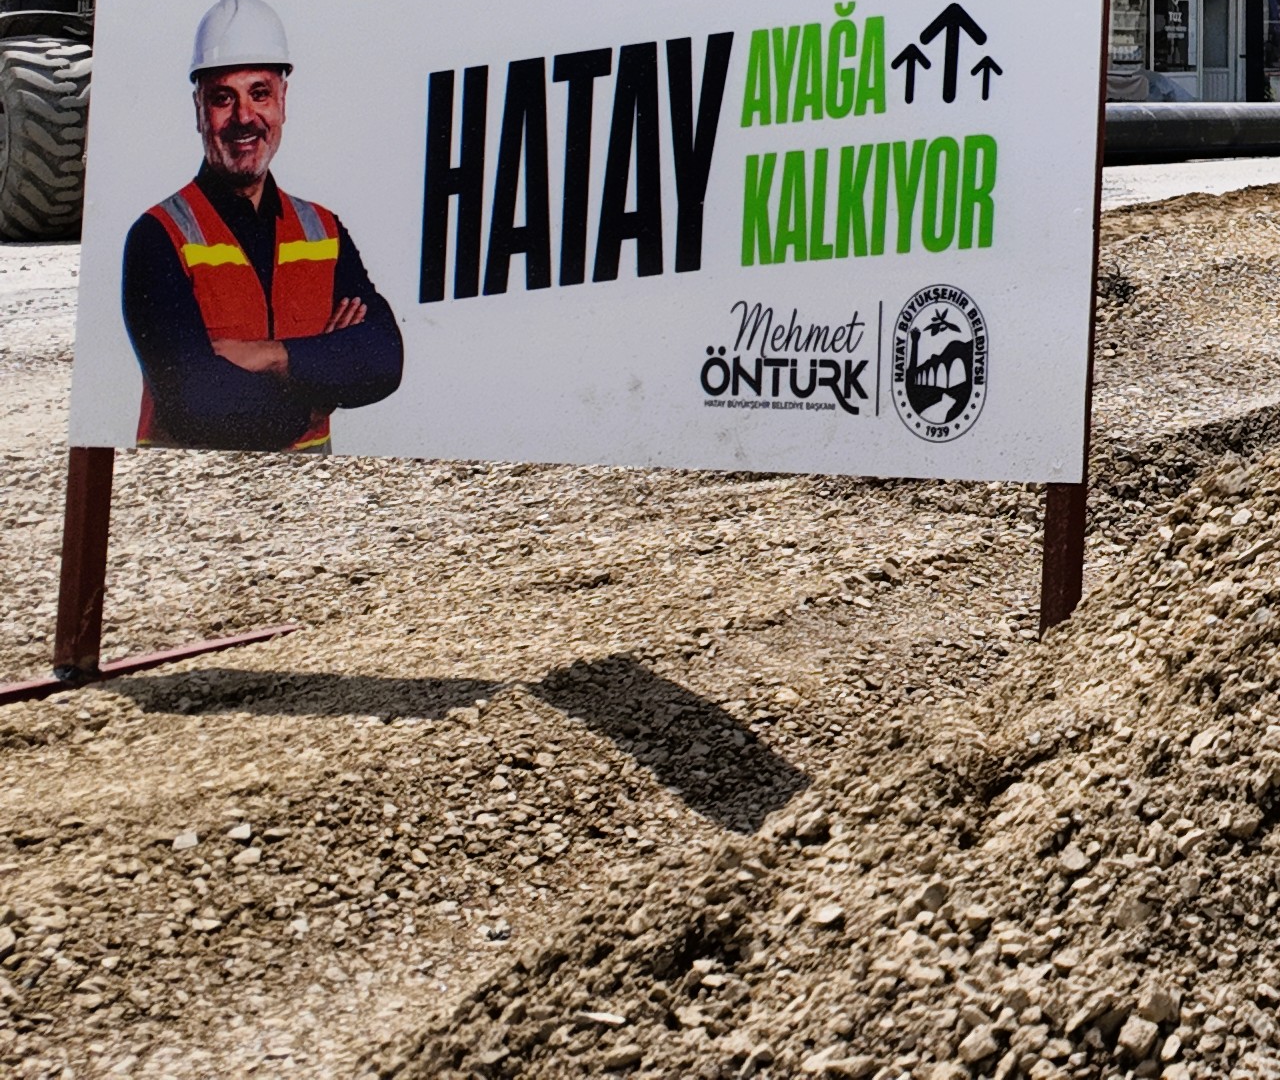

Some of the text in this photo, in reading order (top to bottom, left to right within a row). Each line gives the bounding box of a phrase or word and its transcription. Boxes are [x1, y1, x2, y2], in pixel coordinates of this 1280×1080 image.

[740, 1, 886, 128] AYAĞA
[418, 31, 735, 304] HATAY
[740, 134, 997, 267] KALKIYOR
[730, 300, 866, 358] Mehmet
[895, 336, 906, 382] HATAY
[772, 401, 804, 410] BELEDİYE
[925, 425, 950, 438] 1939
